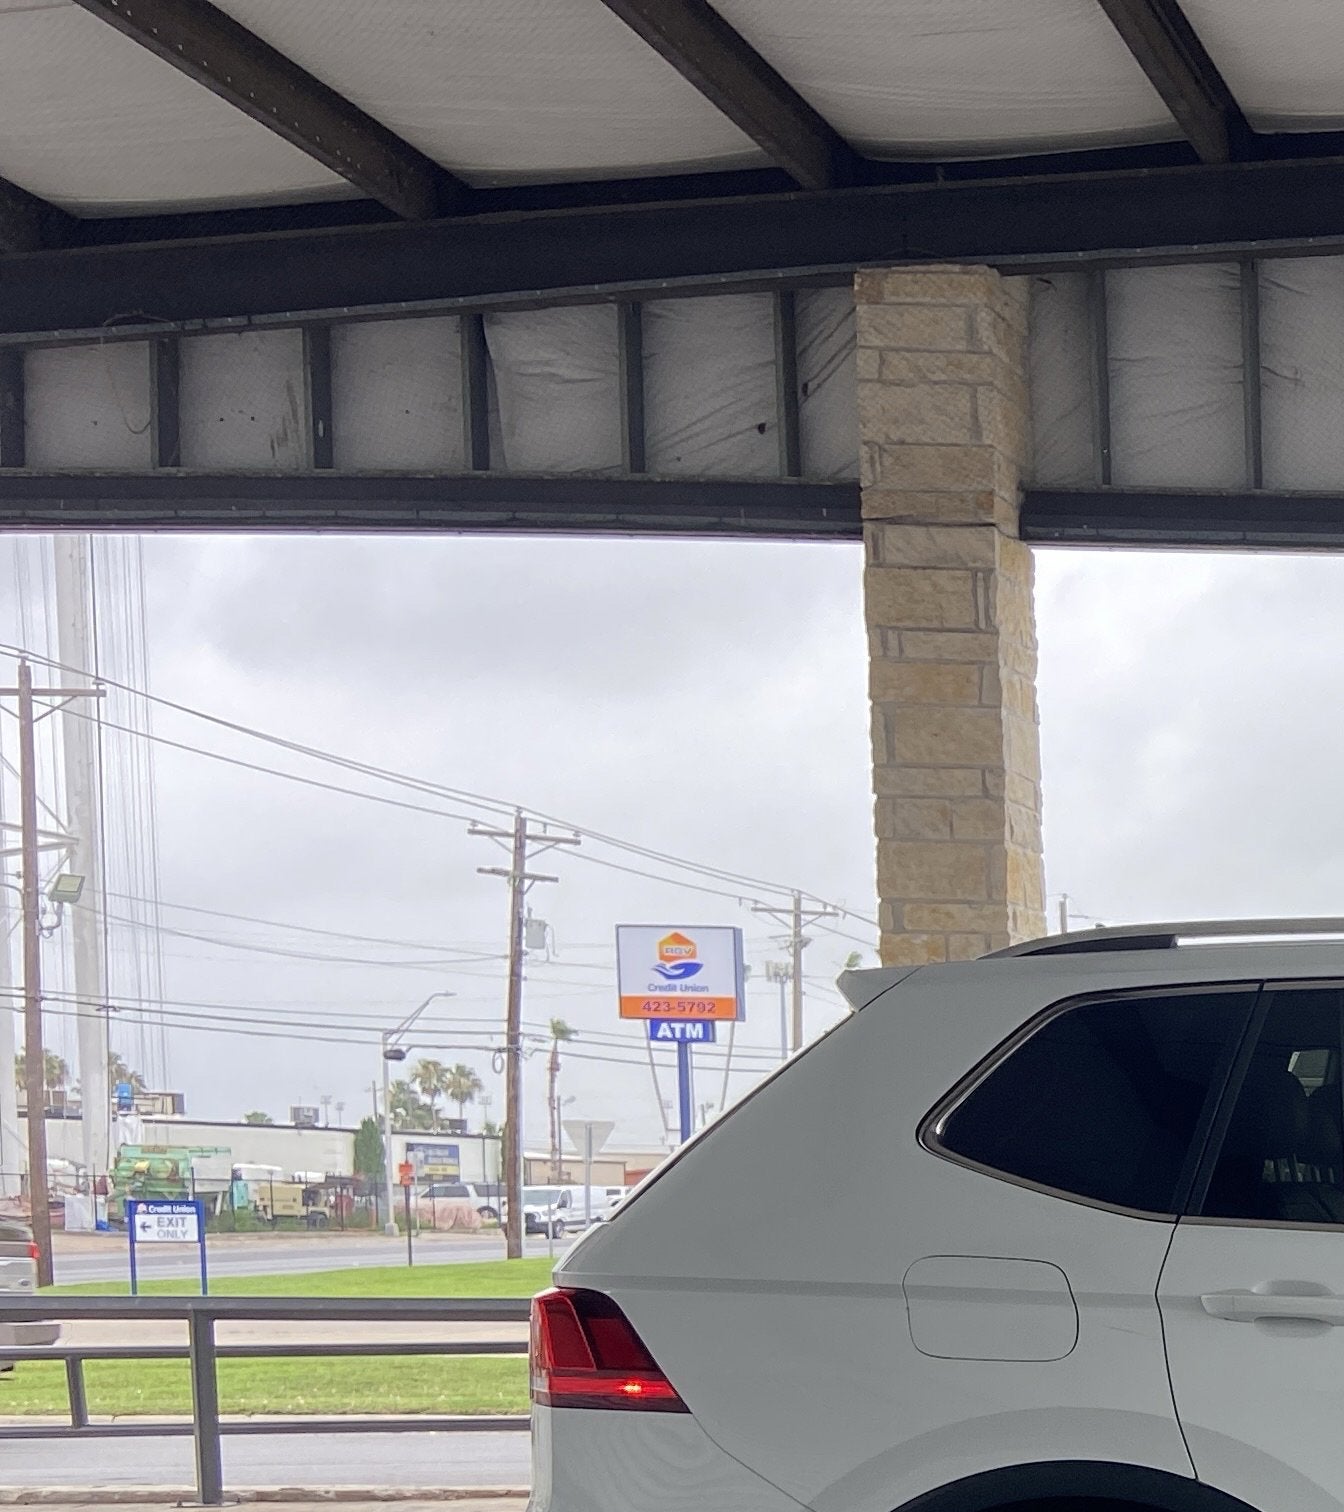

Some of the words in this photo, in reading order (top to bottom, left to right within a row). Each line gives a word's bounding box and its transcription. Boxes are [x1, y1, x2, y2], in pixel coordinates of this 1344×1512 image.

[647, 983, 677, 992] Credit
[679, 984, 709, 993] Union
[642, 1001, 716, 1014] 423-5792
[656, 1022, 704, 1039] ATM
[148, 1204, 172, 1214] Credit
[173, 1204, 196, 1214] Union
[156, 1216, 187, 1228] EXIT
[156, 1229, 188, 1239] ONLY
